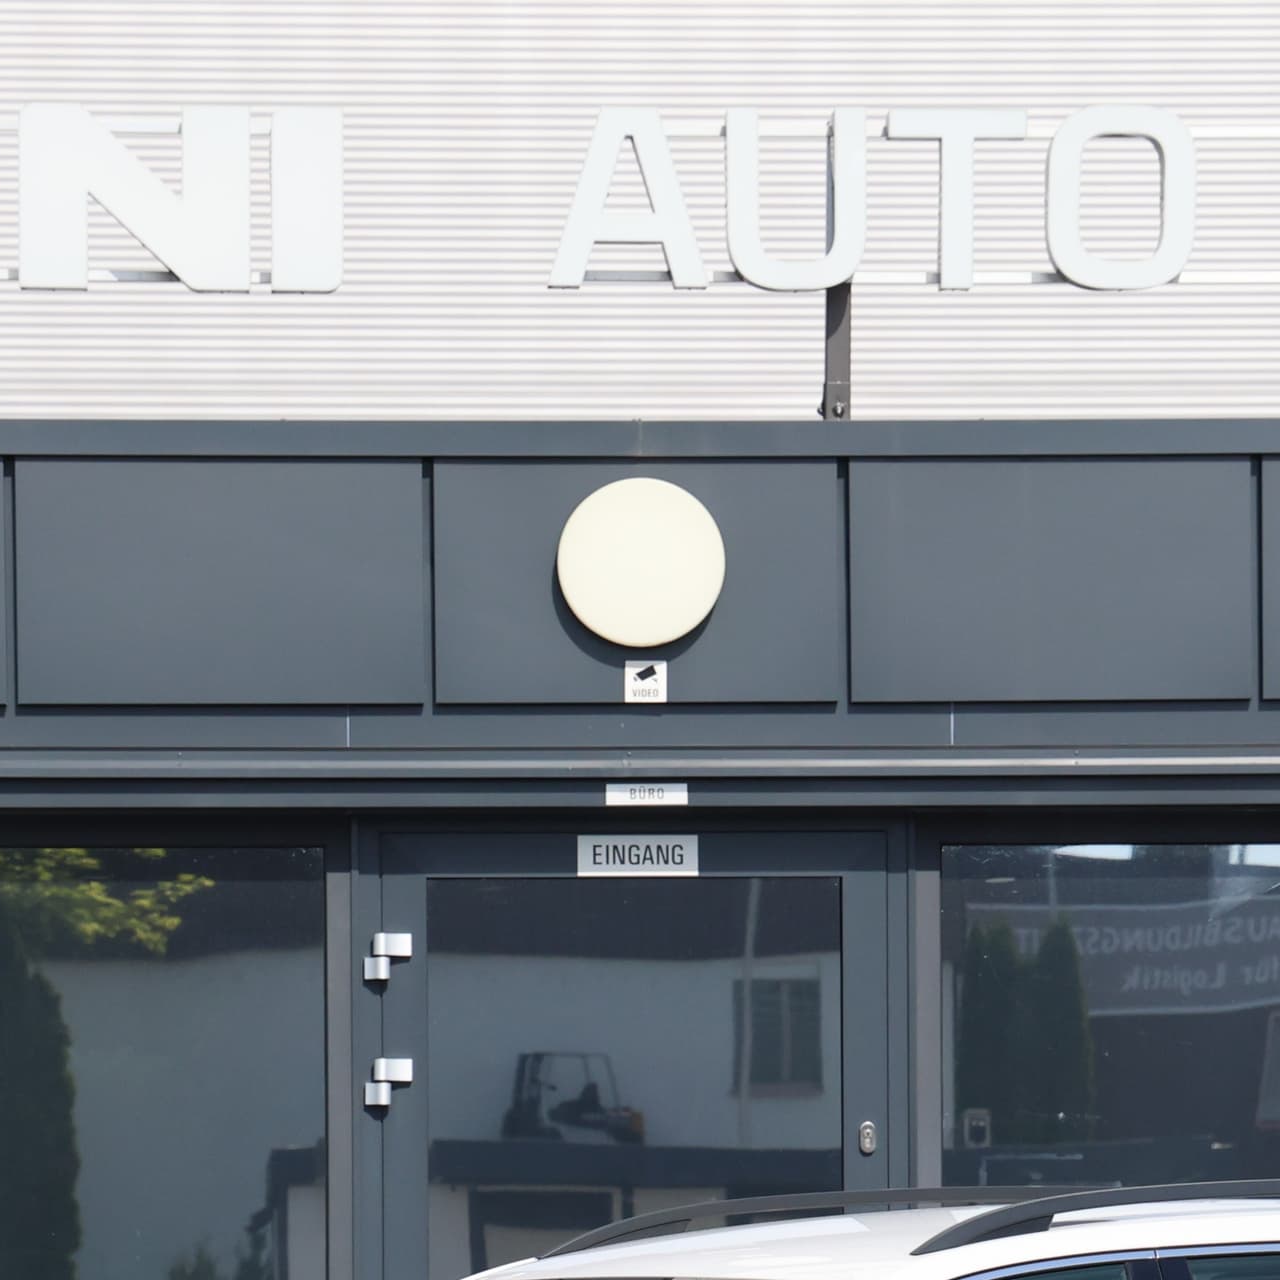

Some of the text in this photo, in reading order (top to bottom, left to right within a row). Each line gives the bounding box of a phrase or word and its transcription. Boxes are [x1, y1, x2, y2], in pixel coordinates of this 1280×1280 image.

[547, 102, 1198, 292] AUTO
[631, 687, 660, 698] VIDEO
[628, 785, 665, 800] BÜRO
[591, 843, 685, 866] EINGANG
